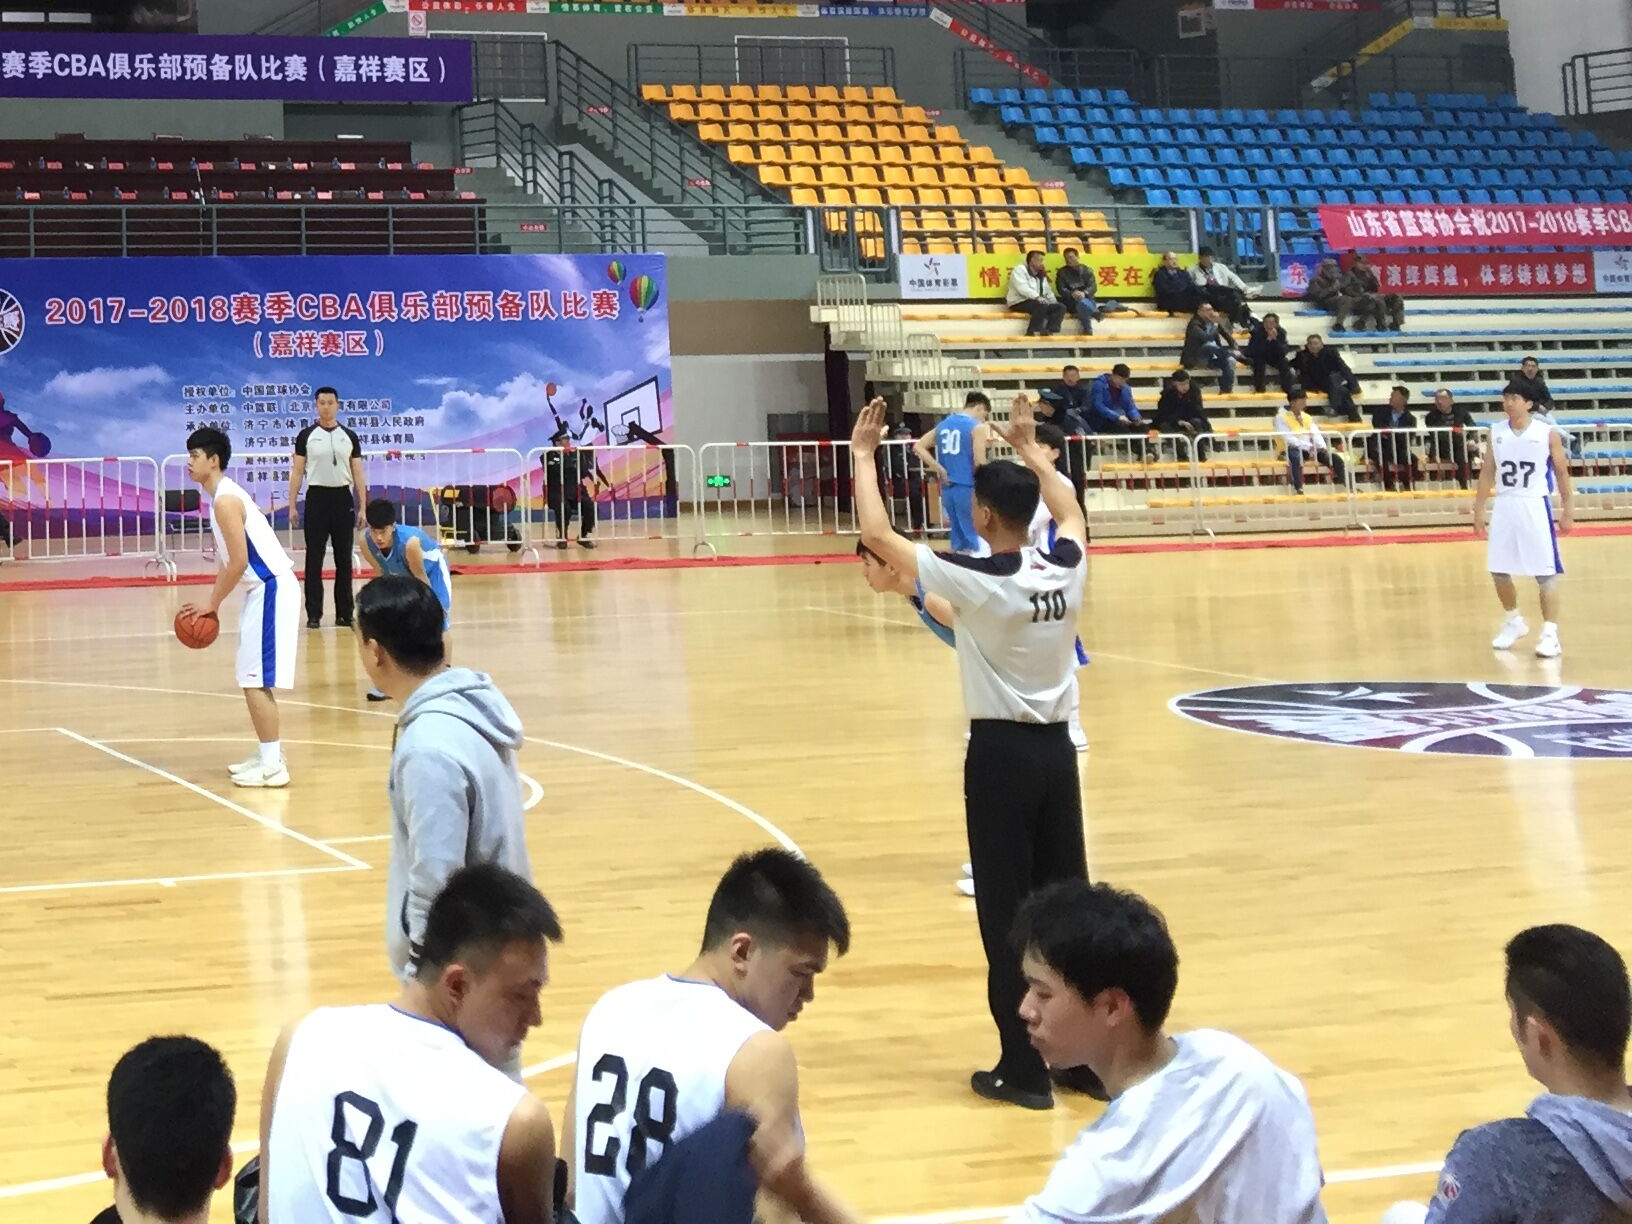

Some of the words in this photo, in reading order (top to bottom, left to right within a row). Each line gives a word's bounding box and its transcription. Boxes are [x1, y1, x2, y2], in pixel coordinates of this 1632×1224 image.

[253, 329, 386, 359] （嘉祥赛区）
[242, 384, 311, 396] 中国篮球协会
[940, 429, 961, 455] 30
[1501, 460, 1536, 488] 27
[1029, 589, 1066, 623] 110
[584, 1052, 679, 1178] 28
[326, 1090, 418, 1219] 81
